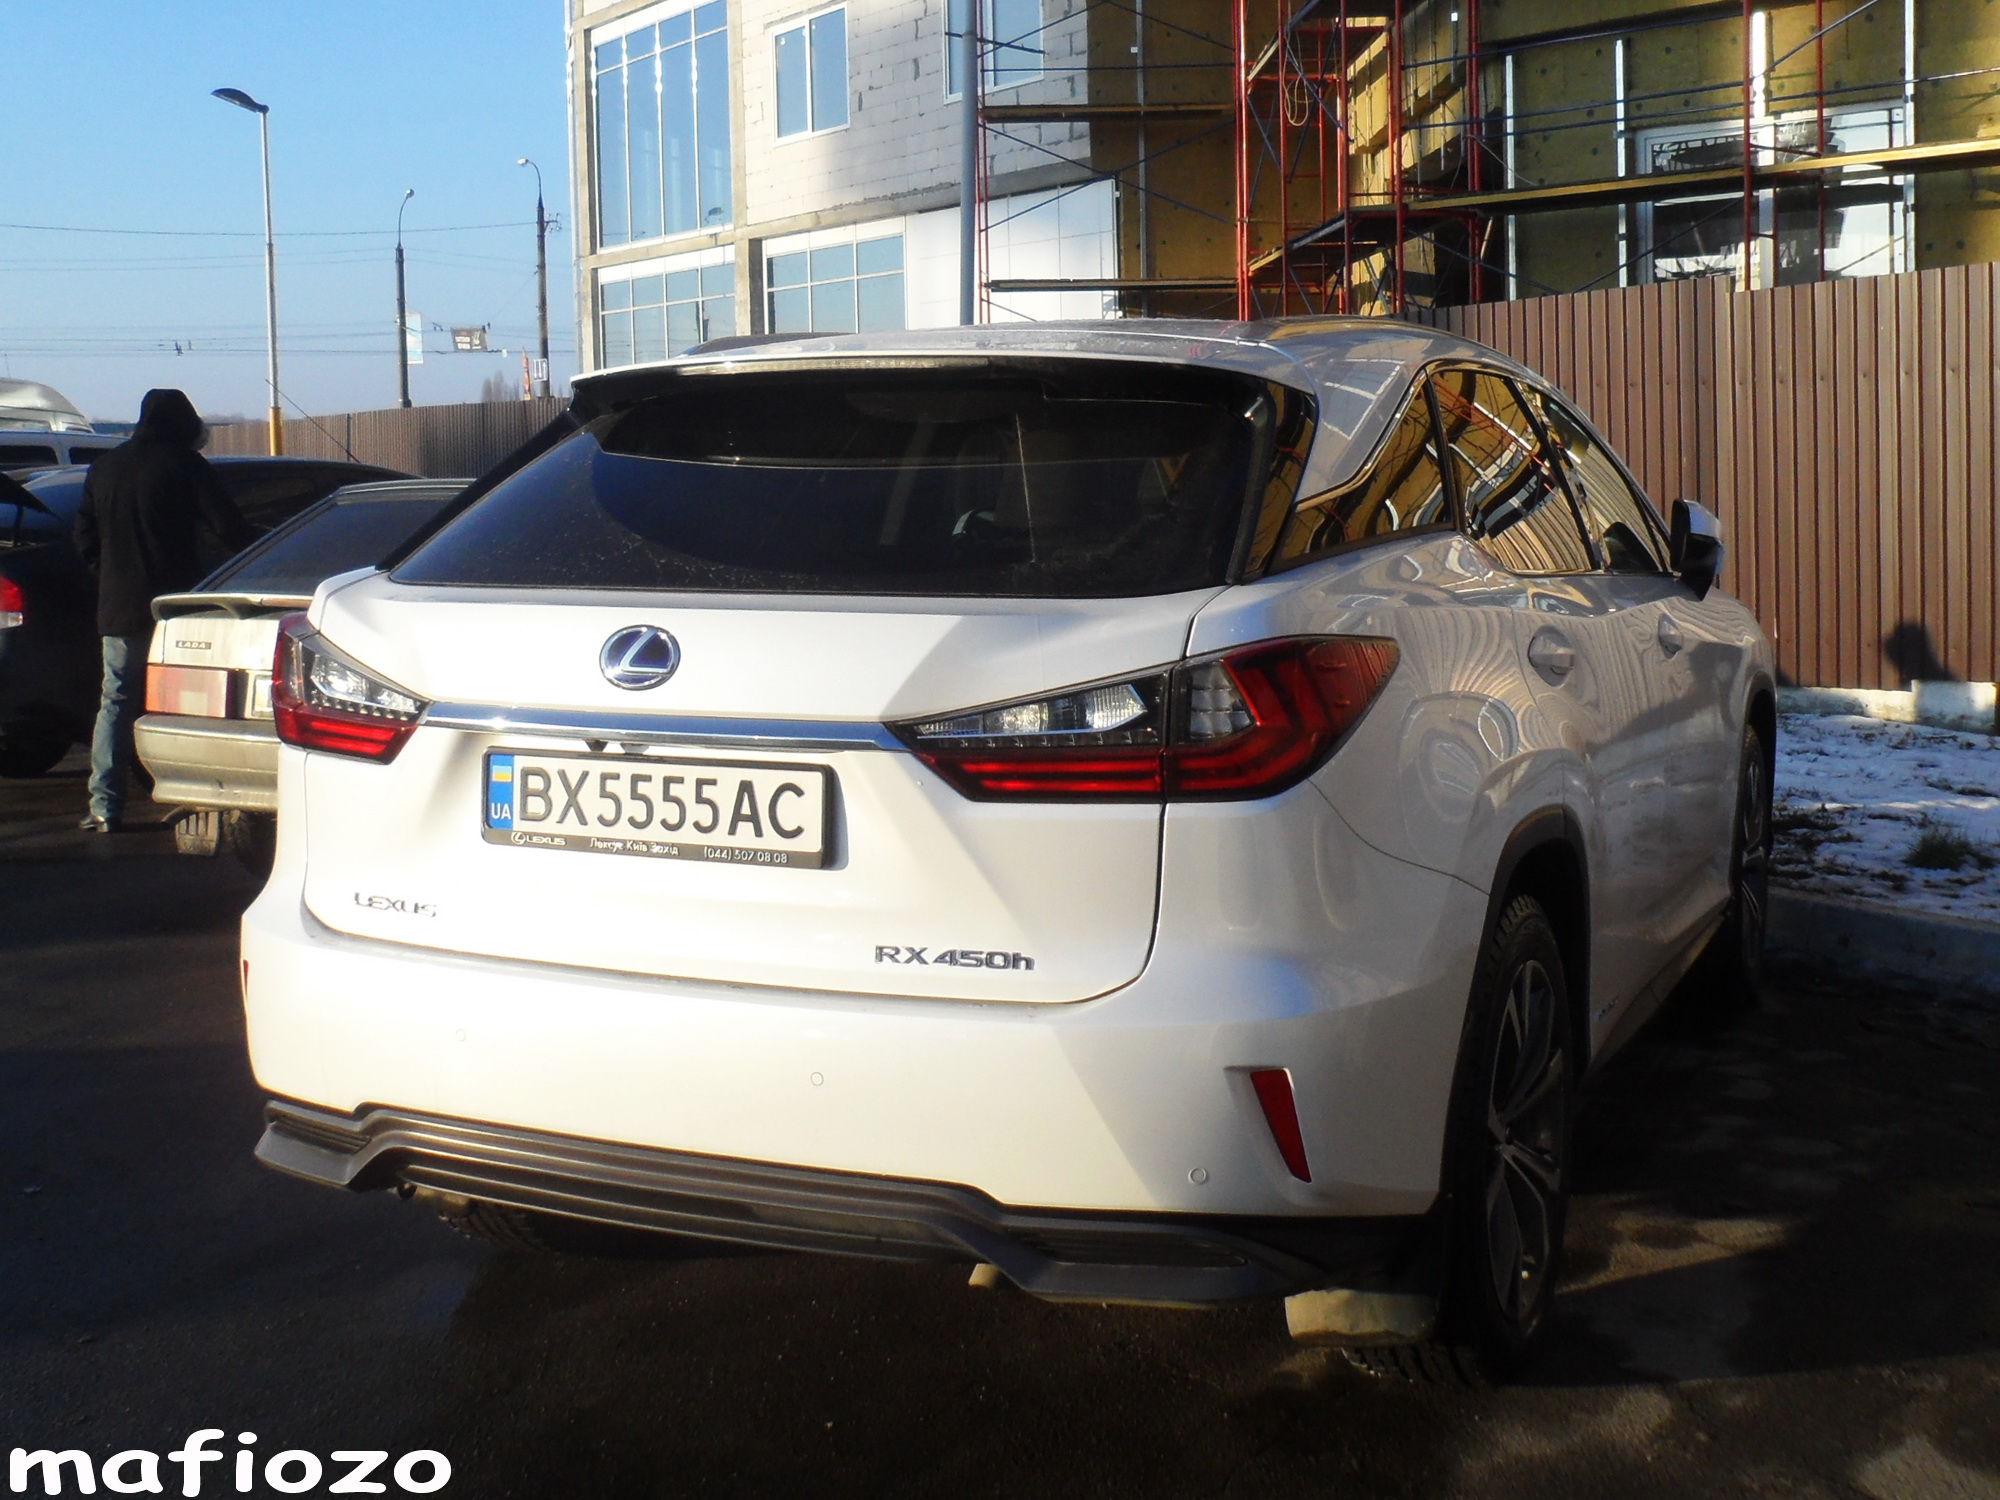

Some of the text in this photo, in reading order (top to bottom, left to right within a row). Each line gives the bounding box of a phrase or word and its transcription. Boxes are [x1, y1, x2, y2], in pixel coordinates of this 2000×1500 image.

[177, 640, 207, 649] LADA
[491, 802, 512, 820] UA
[518, 766, 805, 839] BX5555AC
[526, 833, 567, 846] LEXUS
[704, 846, 789, 864] (044) 507 08 08
[354, 892, 437, 918] LEXUS
